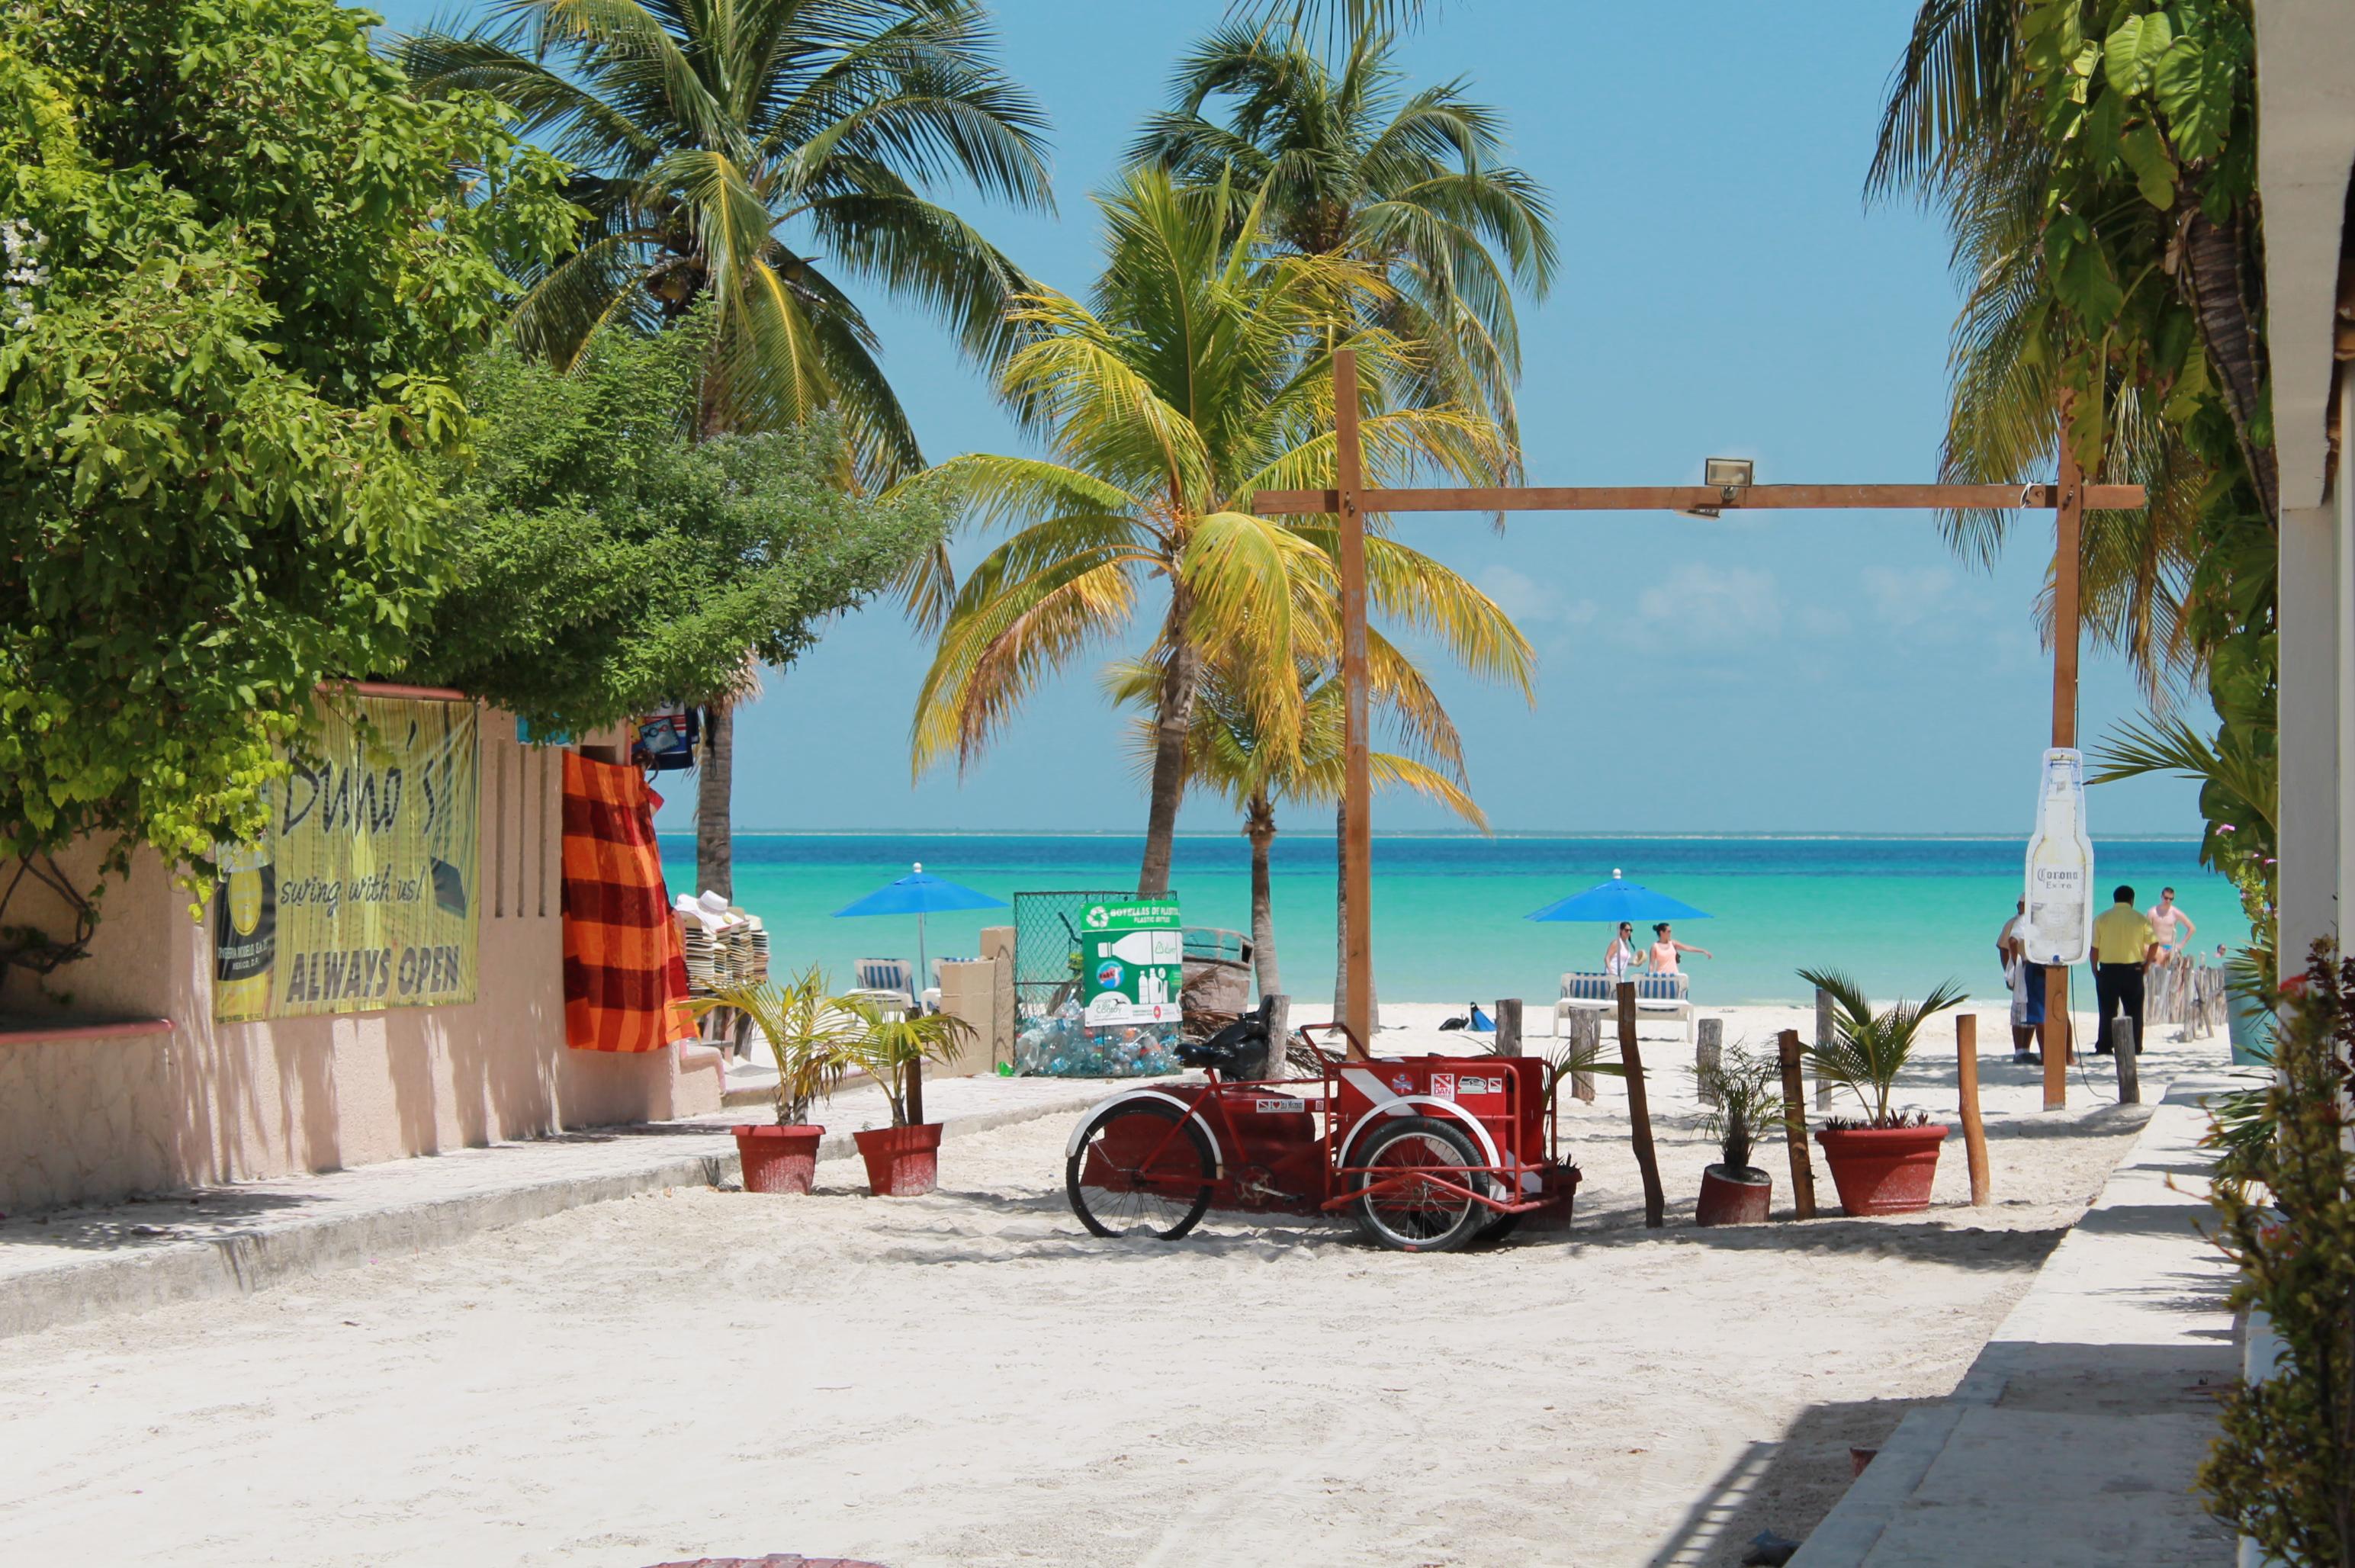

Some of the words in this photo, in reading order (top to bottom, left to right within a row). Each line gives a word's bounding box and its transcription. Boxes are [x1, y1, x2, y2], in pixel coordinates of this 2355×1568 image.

[2037, 868, 2078, 882] Corona
[281, 876, 341, 917] swing
[349, 863, 391, 901] with
[397, 866, 426, 904] us!
[2046, 880, 2072, 889] Exra
[1110, 907, 1150, 917] BOTELLAS
[1152, 907, 1161, 916] DE
[286, 946, 391, 1003] ALWAYS
[397, 945, 459, 996] OPEN
